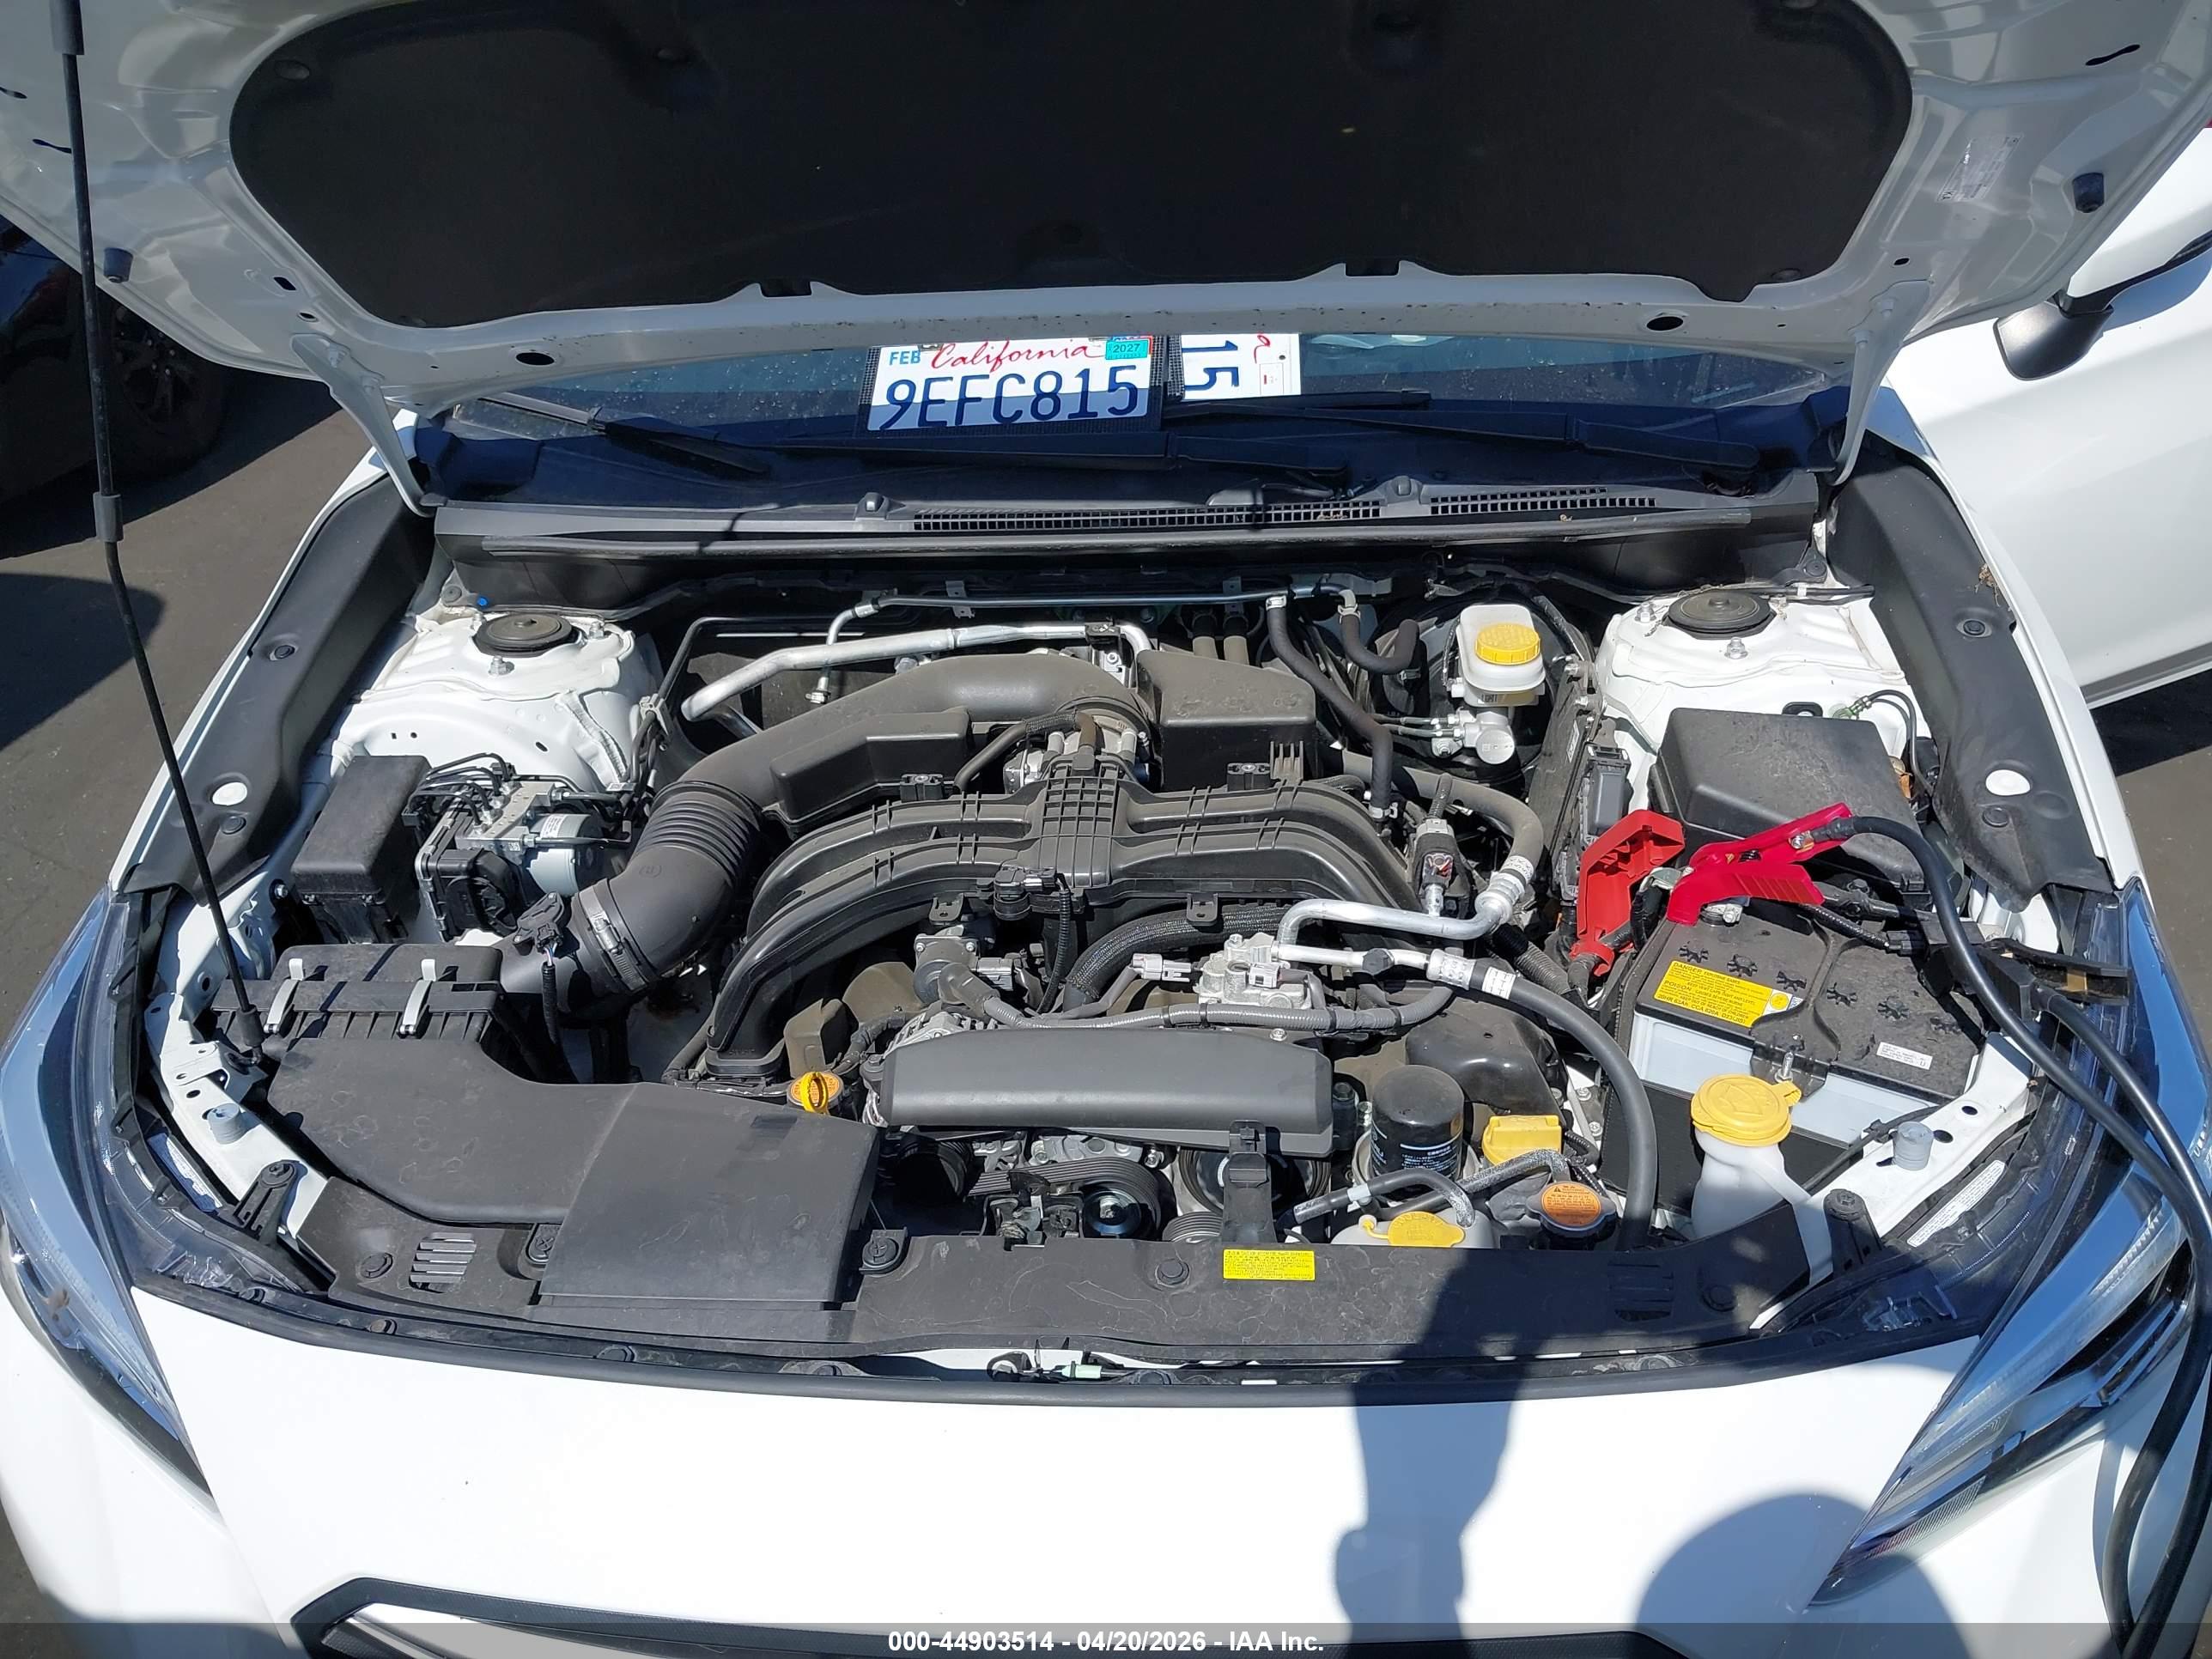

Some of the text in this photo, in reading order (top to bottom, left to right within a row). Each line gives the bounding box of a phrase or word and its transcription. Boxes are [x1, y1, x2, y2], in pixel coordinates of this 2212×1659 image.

[889, 350, 921, 366] FEB
[931, 340, 1105, 373] California
[1112, 343, 1140, 353] 2027
[879, 364, 1139, 430] 9EFC815
